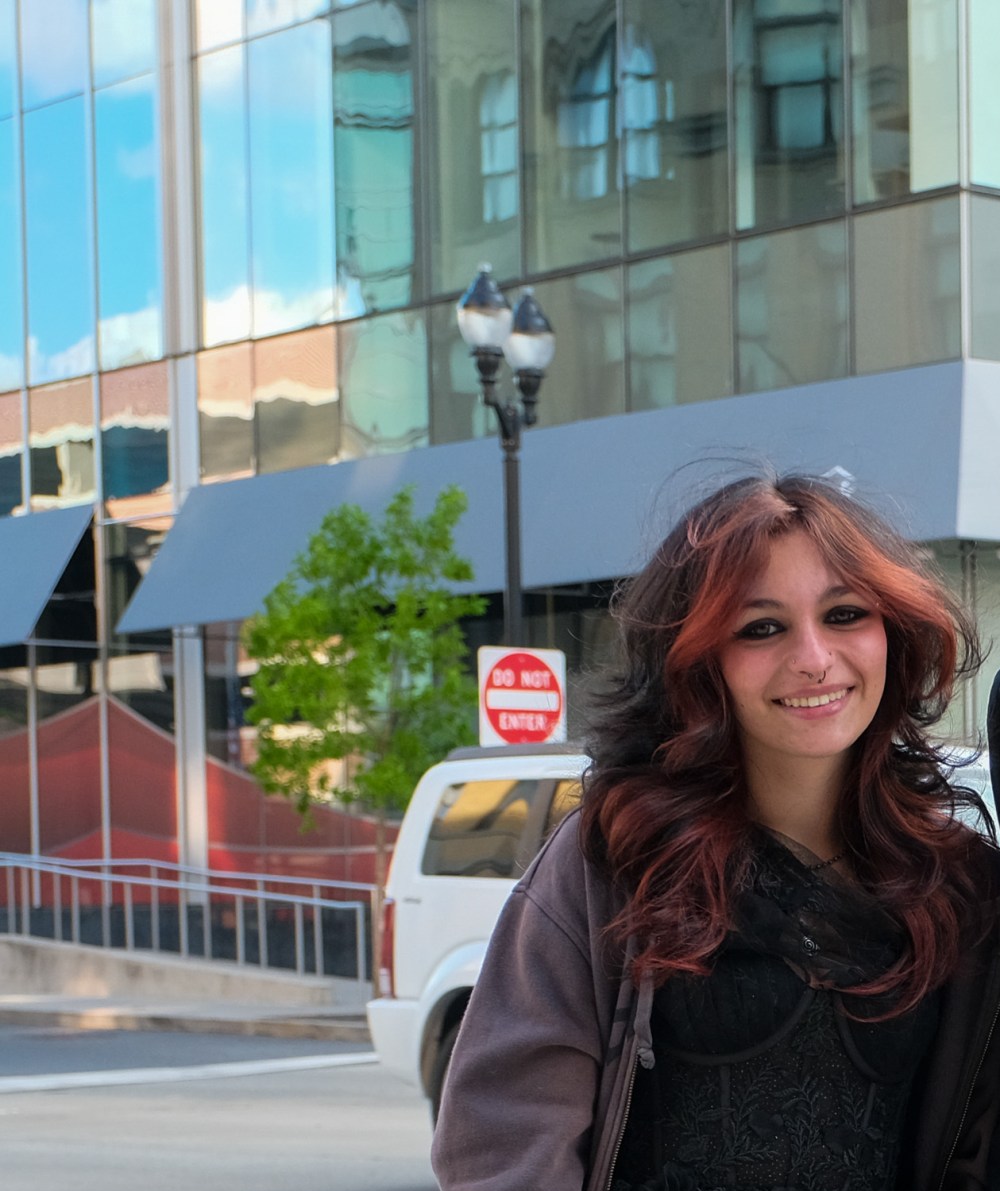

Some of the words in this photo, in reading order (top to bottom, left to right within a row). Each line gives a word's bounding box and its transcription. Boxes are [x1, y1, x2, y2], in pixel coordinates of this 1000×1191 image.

[493, 668, 515, 686] DO
[520, 670, 551, 688] NOT
[499, 712, 546, 731] ENTER
